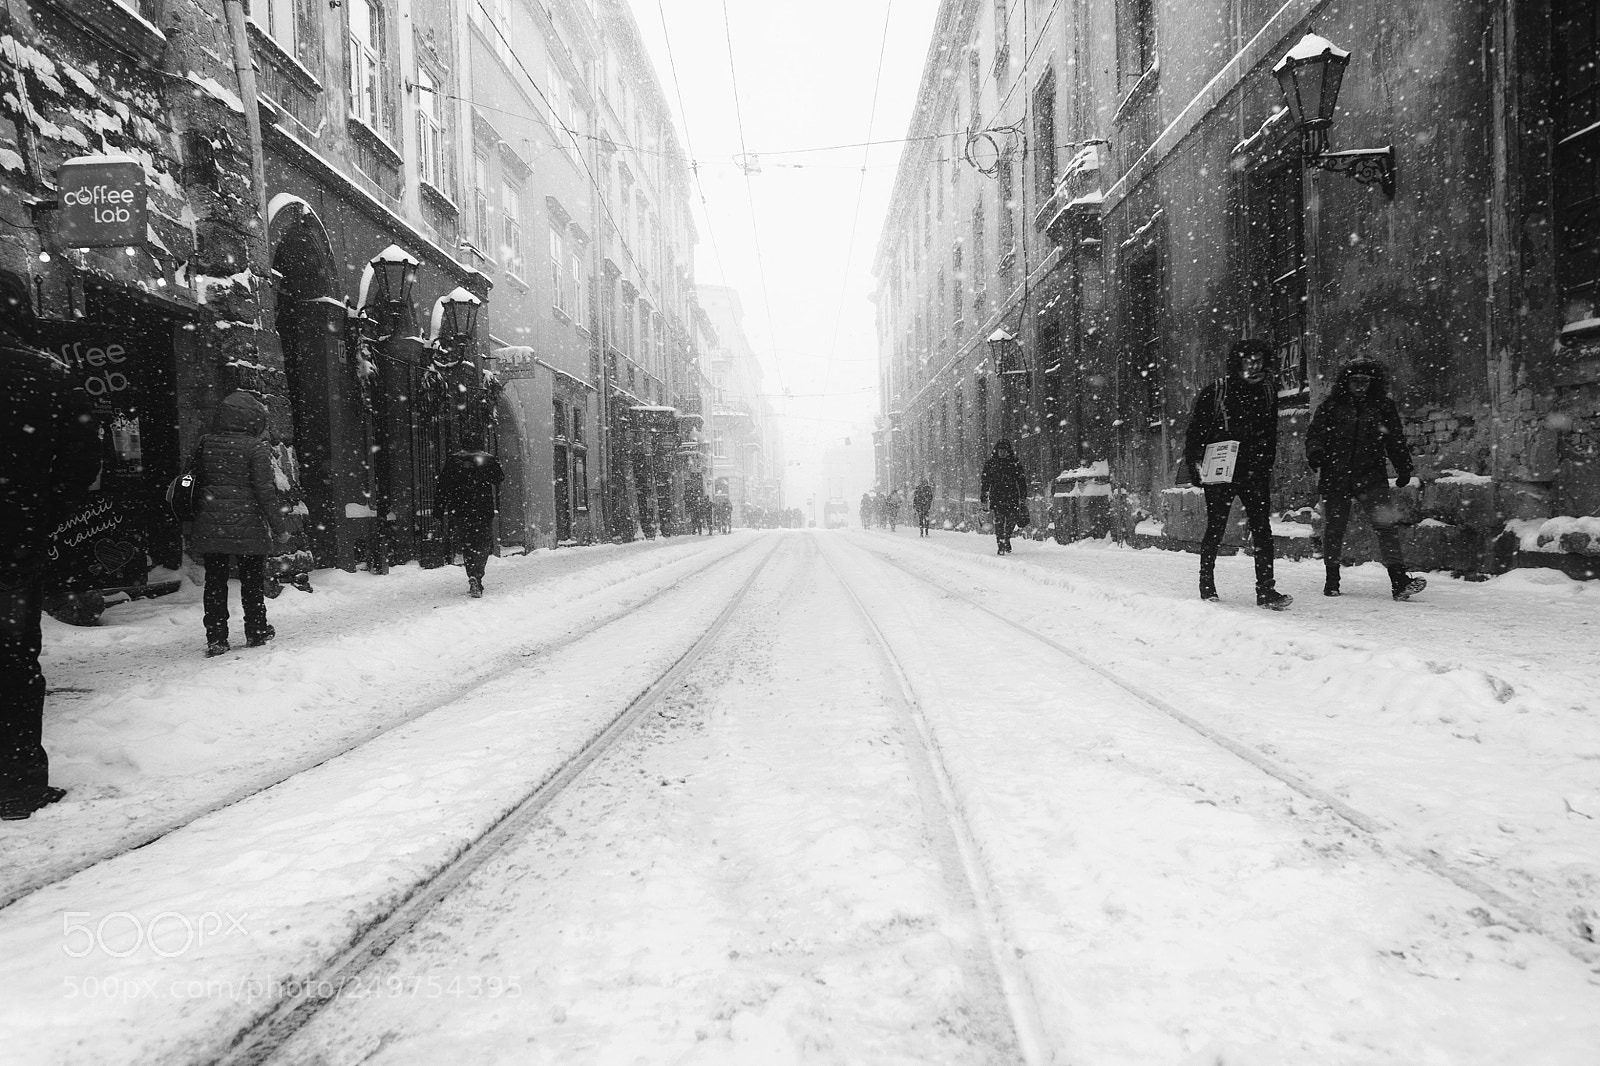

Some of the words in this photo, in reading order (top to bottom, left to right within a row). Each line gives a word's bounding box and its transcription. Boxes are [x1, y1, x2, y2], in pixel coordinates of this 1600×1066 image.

[64, 185, 134, 206] coffee
[46, 341, 127, 369] ffee
[73, 370, 128, 396] ab
